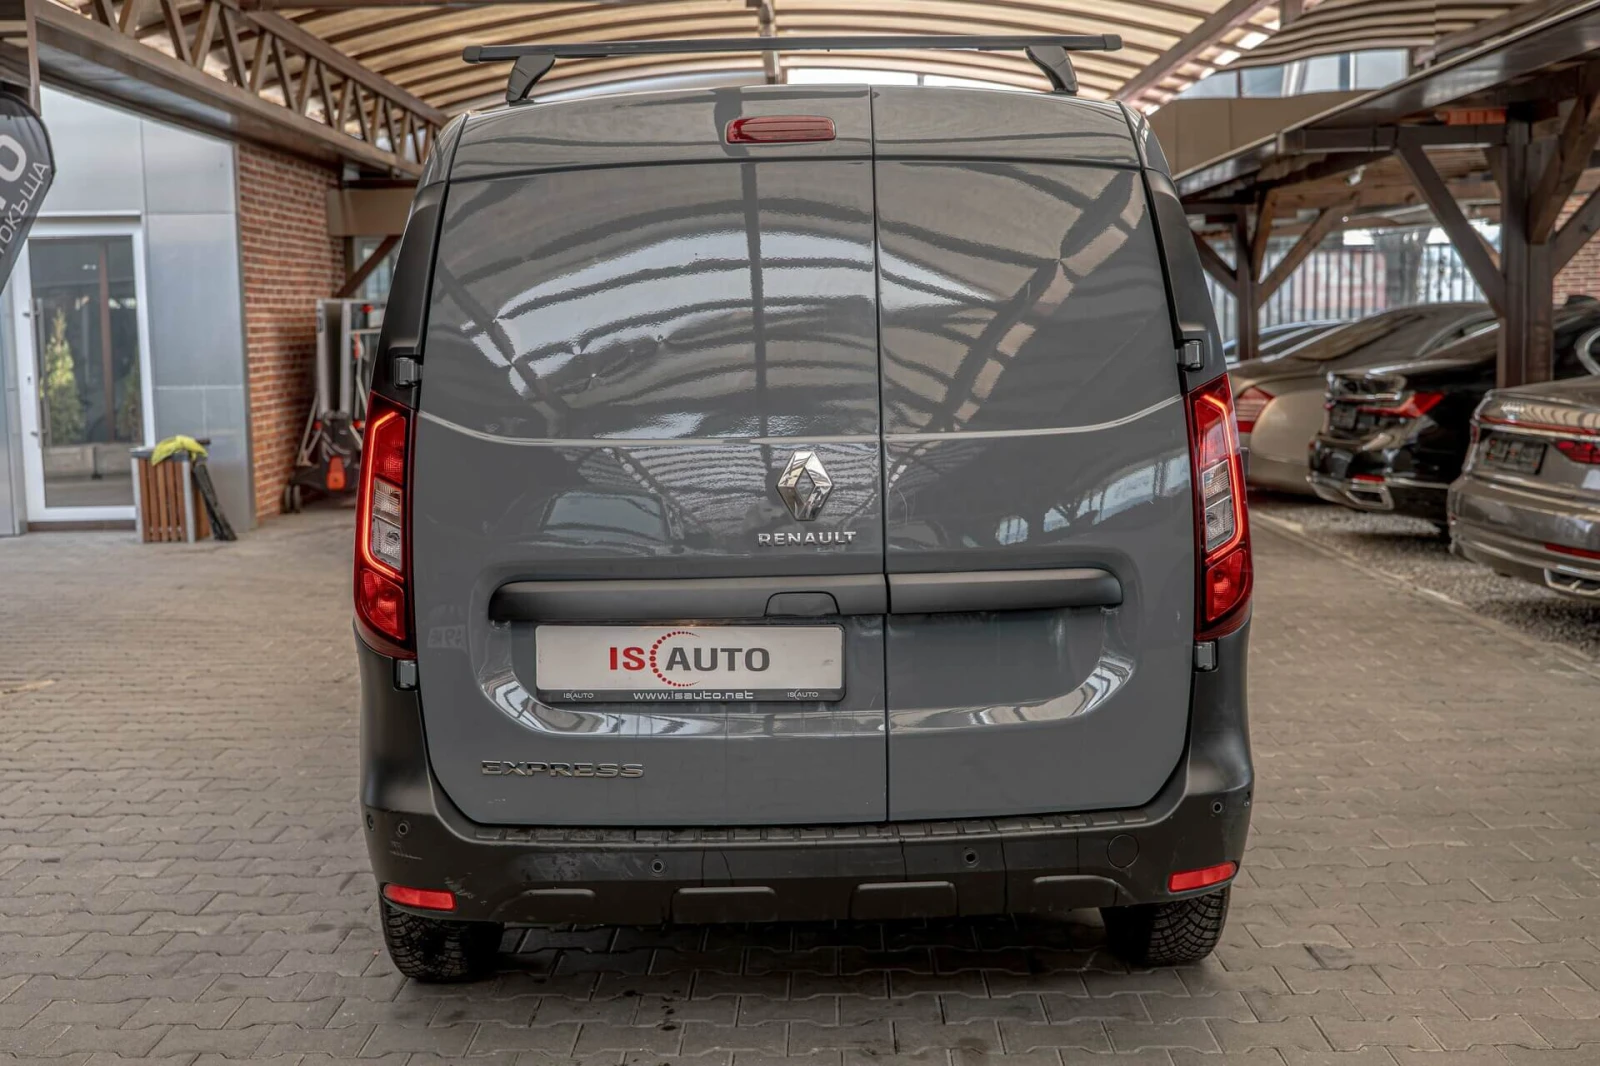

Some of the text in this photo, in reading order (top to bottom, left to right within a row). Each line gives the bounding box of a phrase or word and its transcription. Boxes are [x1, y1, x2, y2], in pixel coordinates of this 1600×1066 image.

[0, 161, 50, 254] ОКЪЩА
[757, 531, 857, 547] RENAULT
[633, 690, 754, 700] www.isauto.net
[481, 760, 645, 778] EXPRESS
